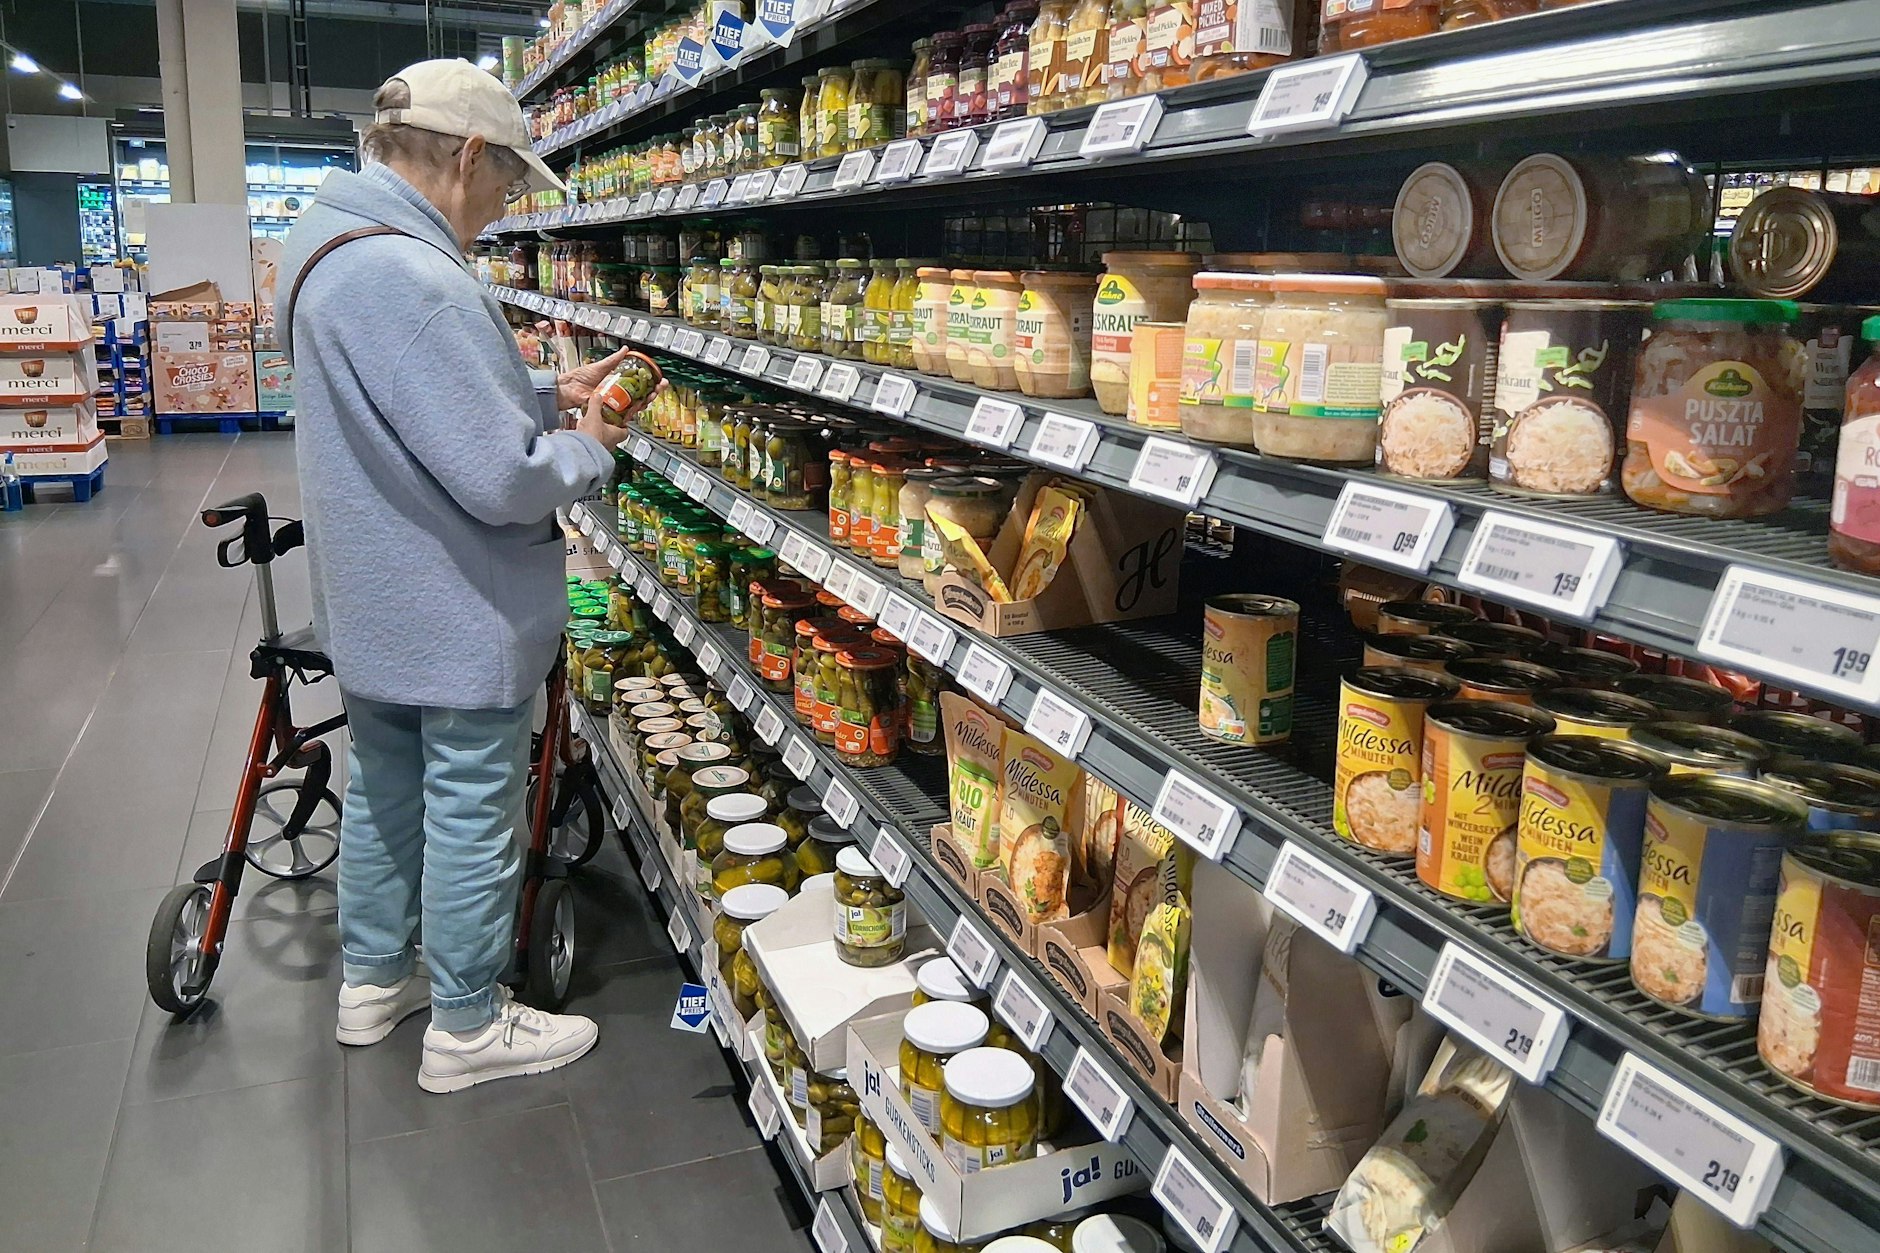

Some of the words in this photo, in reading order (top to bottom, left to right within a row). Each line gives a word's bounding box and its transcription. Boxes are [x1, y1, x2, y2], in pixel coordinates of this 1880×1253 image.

[766, 0, 792, 14] TIEF
[1201, 1, 1223, 15] MIXED
[767, 13, 788, 24] PREIS
[1198, 11, 1225, 29] PICKLES
[718, 24, 741, 39] TIEF
[717, 36, 737, 48] PREIS
[679, 48, 700, 61] TIEF
[677, 59, 698, 69] PREIS
[2, 323, 53, 335] merci
[17, 343, 45, 351] merci
[172, 372, 214, 386] CROSSIES
[178, 366, 209, 378] CHOCO
[8, 377, 60, 389] merci
[22, 396, 49, 404] merci
[1685, 398, 1764, 424] PUSZTA
[11, 426, 62, 439] merci
[1690, 422, 1757, 447] SALAT
[26, 445, 53, 453] merci
[16, 458, 67, 470] merci
[1393, 531, 1418, 553] 0.99
[1553, 572, 1581, 597] 1.59
[1832, 647, 1871, 678] 1.99
[954, 720, 1000, 761] Mildessa
[1341, 740, 1351, 760] 2
[1351, 748, 1395, 766] MINUTEN
[1005, 758, 1062, 806] Mildessa
[959, 780, 983, 810] BIO
[1008, 781, 1019, 801] 2
[1018, 789, 1049, 811] MINUTEN
[1473, 795, 1491, 815] 2
[955, 807, 976, 831] KRAUT
[1454, 811, 1468, 820] MIT
[1124, 821, 1139, 840] 2
[1197, 823, 1215, 842] 2.19
[1460, 834, 1483, 846] WEIN
[1527, 826, 1574, 854] MINUTEN
[1451, 841, 1480, 856] SAUER
[1451, 851, 1480, 866] KRAUT
[851, 909, 861, 920] ja!
[1324, 908, 1346, 930] 2.19
[852, 923, 887, 932] CORNICHONS
[681, 997, 705, 1008] TIEF
[684, 1007, 702, 1015] PREIS
[1504, 1028, 1533, 1054] 2.19
[1853, 1032, 1873, 1044] 400
[1873, 1034, 1880, 1047] g
[864, 1059, 881, 1098] ja!
[884, 1095, 935, 1184] GURKENSTICKS
[989, 1148, 1004, 1162] ja!
[1061, 1155, 1101, 1204] ja!
[1702, 1160, 1740, 1192] 2.19
[1197, 1216, 1214, 1238] 0.99
